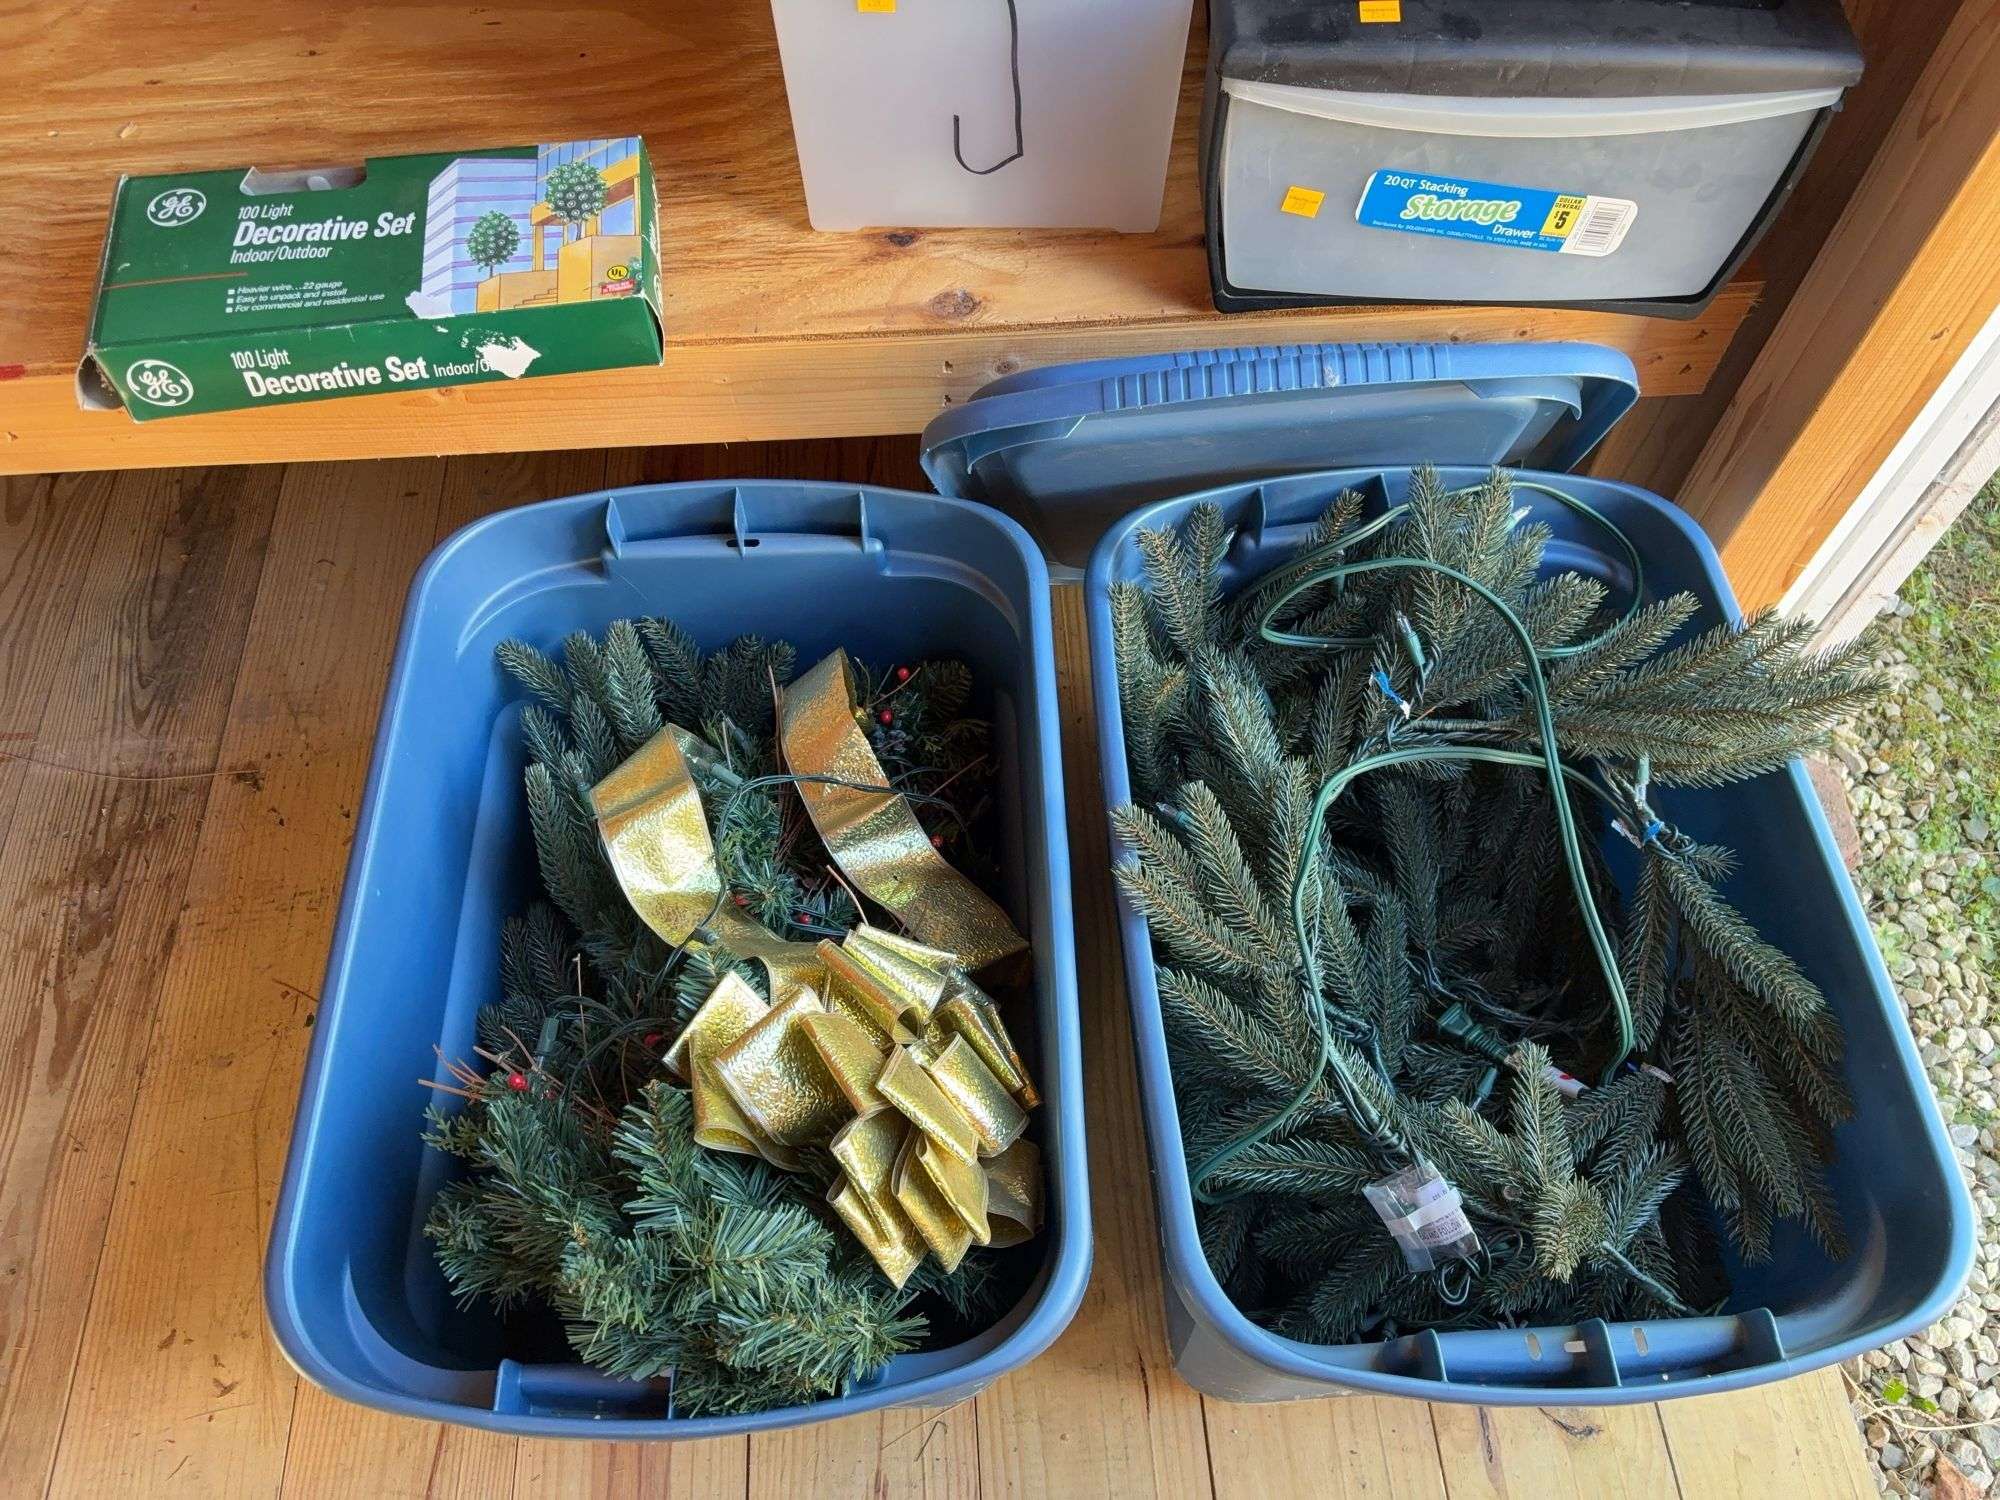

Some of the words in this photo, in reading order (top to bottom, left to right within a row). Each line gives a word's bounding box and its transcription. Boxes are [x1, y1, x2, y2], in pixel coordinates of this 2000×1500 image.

[1418, 180, 1469, 197] Stacking
[238, 205, 260, 220] 100
[260, 203, 294, 221] Light
[1400, 194, 1522, 225] Storage
[1554, 202, 1581, 210] GENERAL
[233, 215, 369, 247] Decorative
[374, 211, 416, 238] Set
[1492, 224, 1538, 238] Drawer
[230, 245, 333, 264] Indoor/Outdoor
[236, 295, 257, 304] Easy
[259, 294, 269, 302] to
[269, 292, 302, 302] unpack
[303, 290, 321, 298] and
[321, 288, 349, 297] install
[237, 286, 270, 294] Heavier
[315, 281, 343, 291] gauge
[234, 304, 250, 313] For
[251, 300, 304, 312] commercial
[303, 299, 322, 307] and
[322, 294, 368, 306] residential
[368, 293, 385, 301] use
[230, 350, 255, 370] 100
[255, 347, 292, 370] Light
[243, 361, 382, 397] Decorative
[384, 355, 430, 382] Set
[433, 358, 493, 378] Indoor/O
